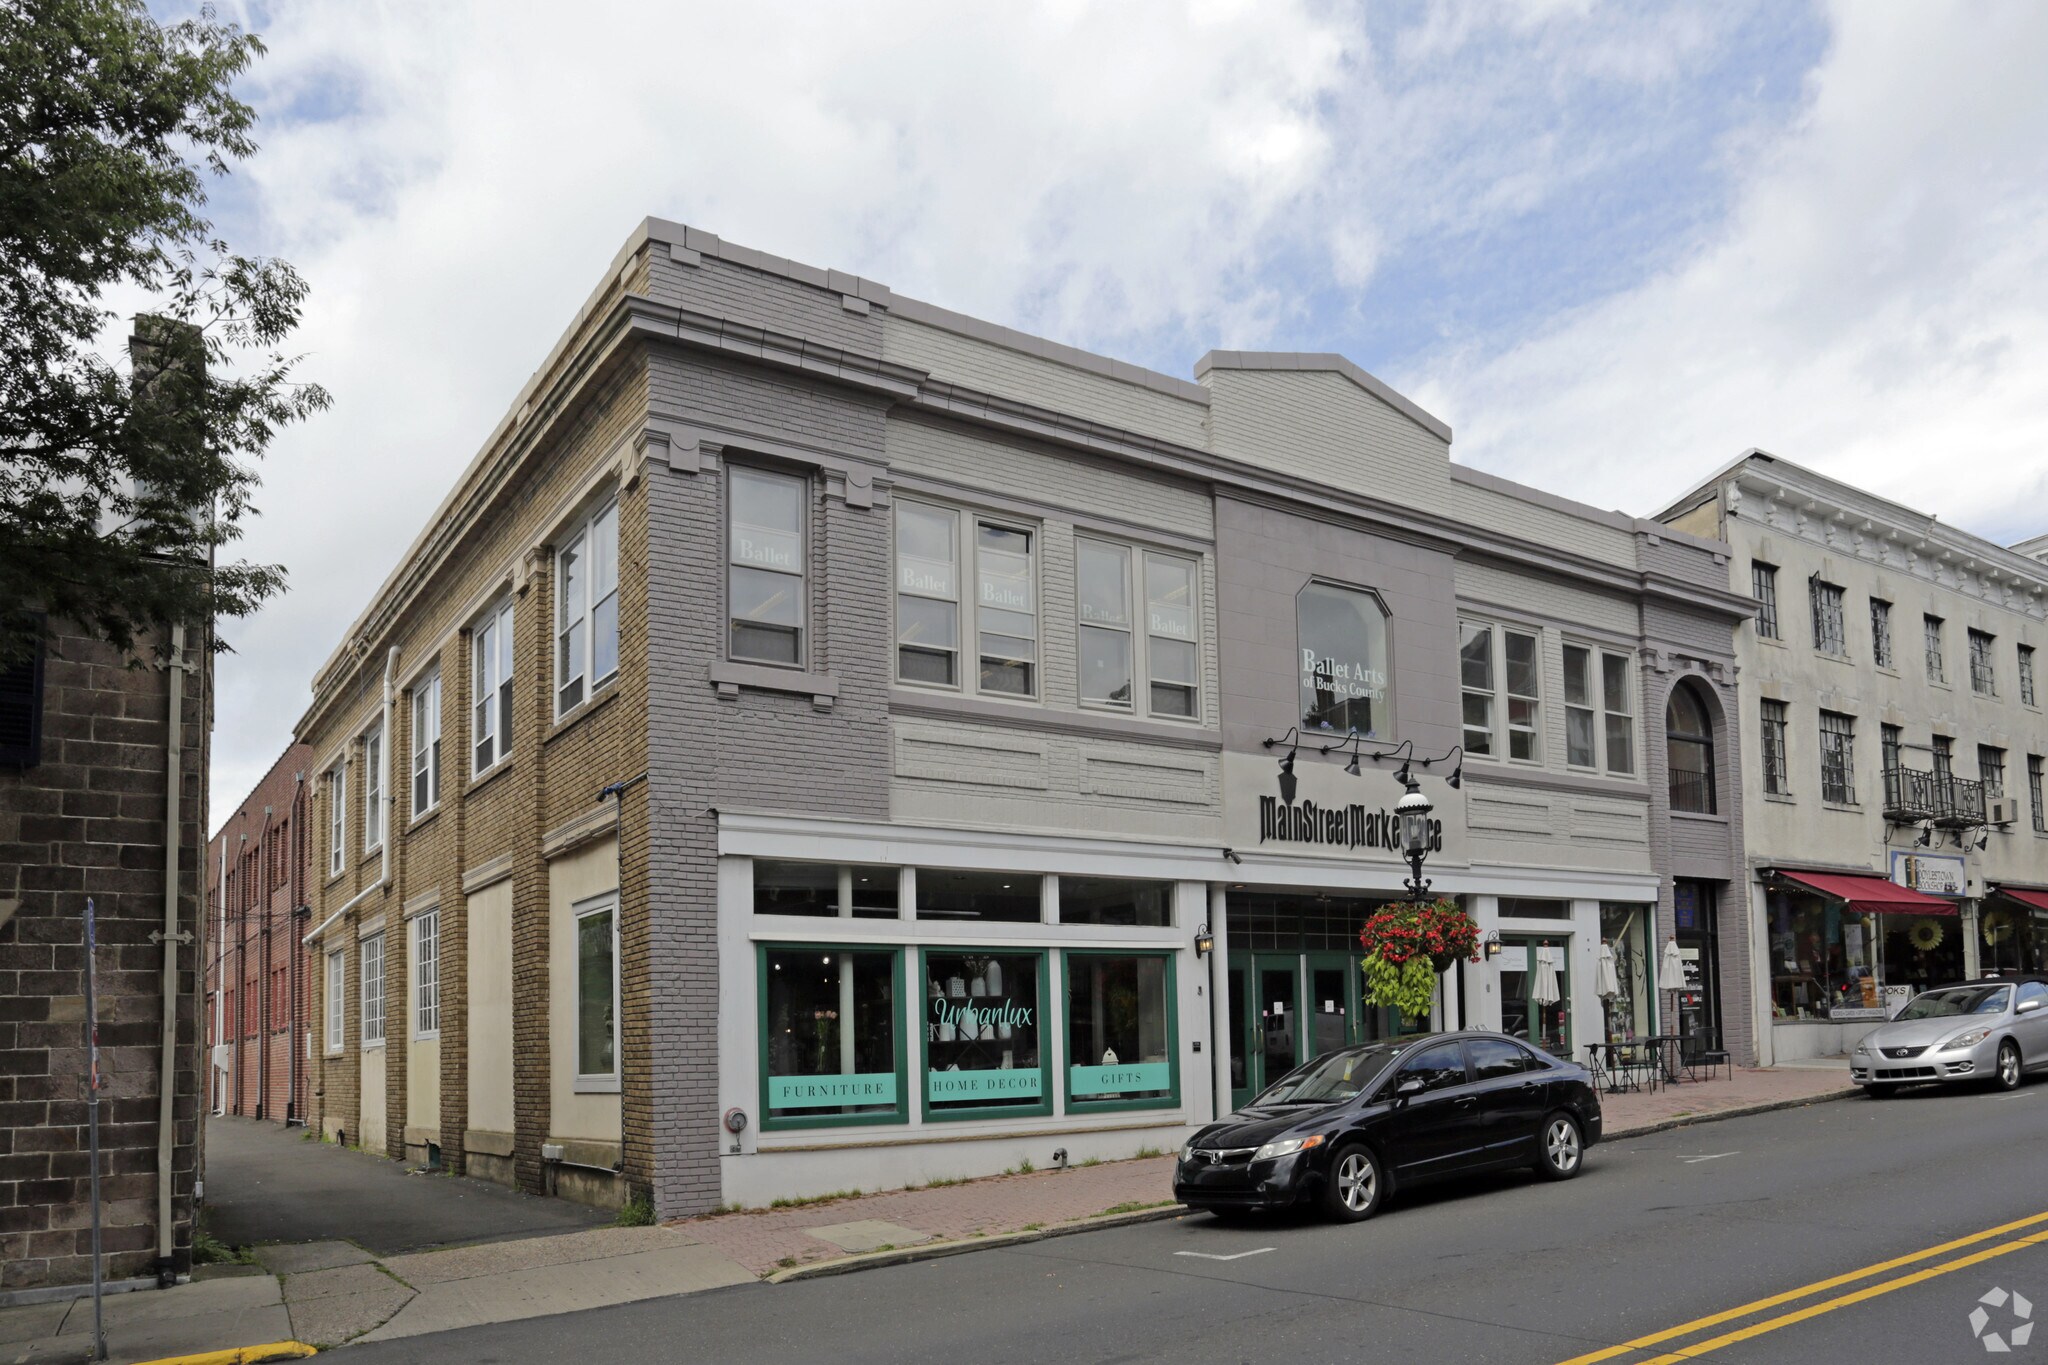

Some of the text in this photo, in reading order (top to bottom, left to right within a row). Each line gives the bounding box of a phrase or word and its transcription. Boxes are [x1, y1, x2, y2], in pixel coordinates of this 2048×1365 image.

[739, 539, 790, 566] Ballet
[903, 567, 946, 593] Ballet
[983, 582, 1025, 607] Ballet
[1151, 614, 1186, 636] Ballet
[1302, 648, 1385, 685] Ballet Arts
[1303, 676, 1385, 703] of Bucks County
[1260, 795, 1441, 852] MainStreetMarkece
[934, 997, 1032, 1029] Urbanlux
[783, 1082, 884, 1098] FURNITURE
[933, 1077, 1038, 1092] HOME DECOR
[1101, 1072, 1142, 1084] GIFTS
